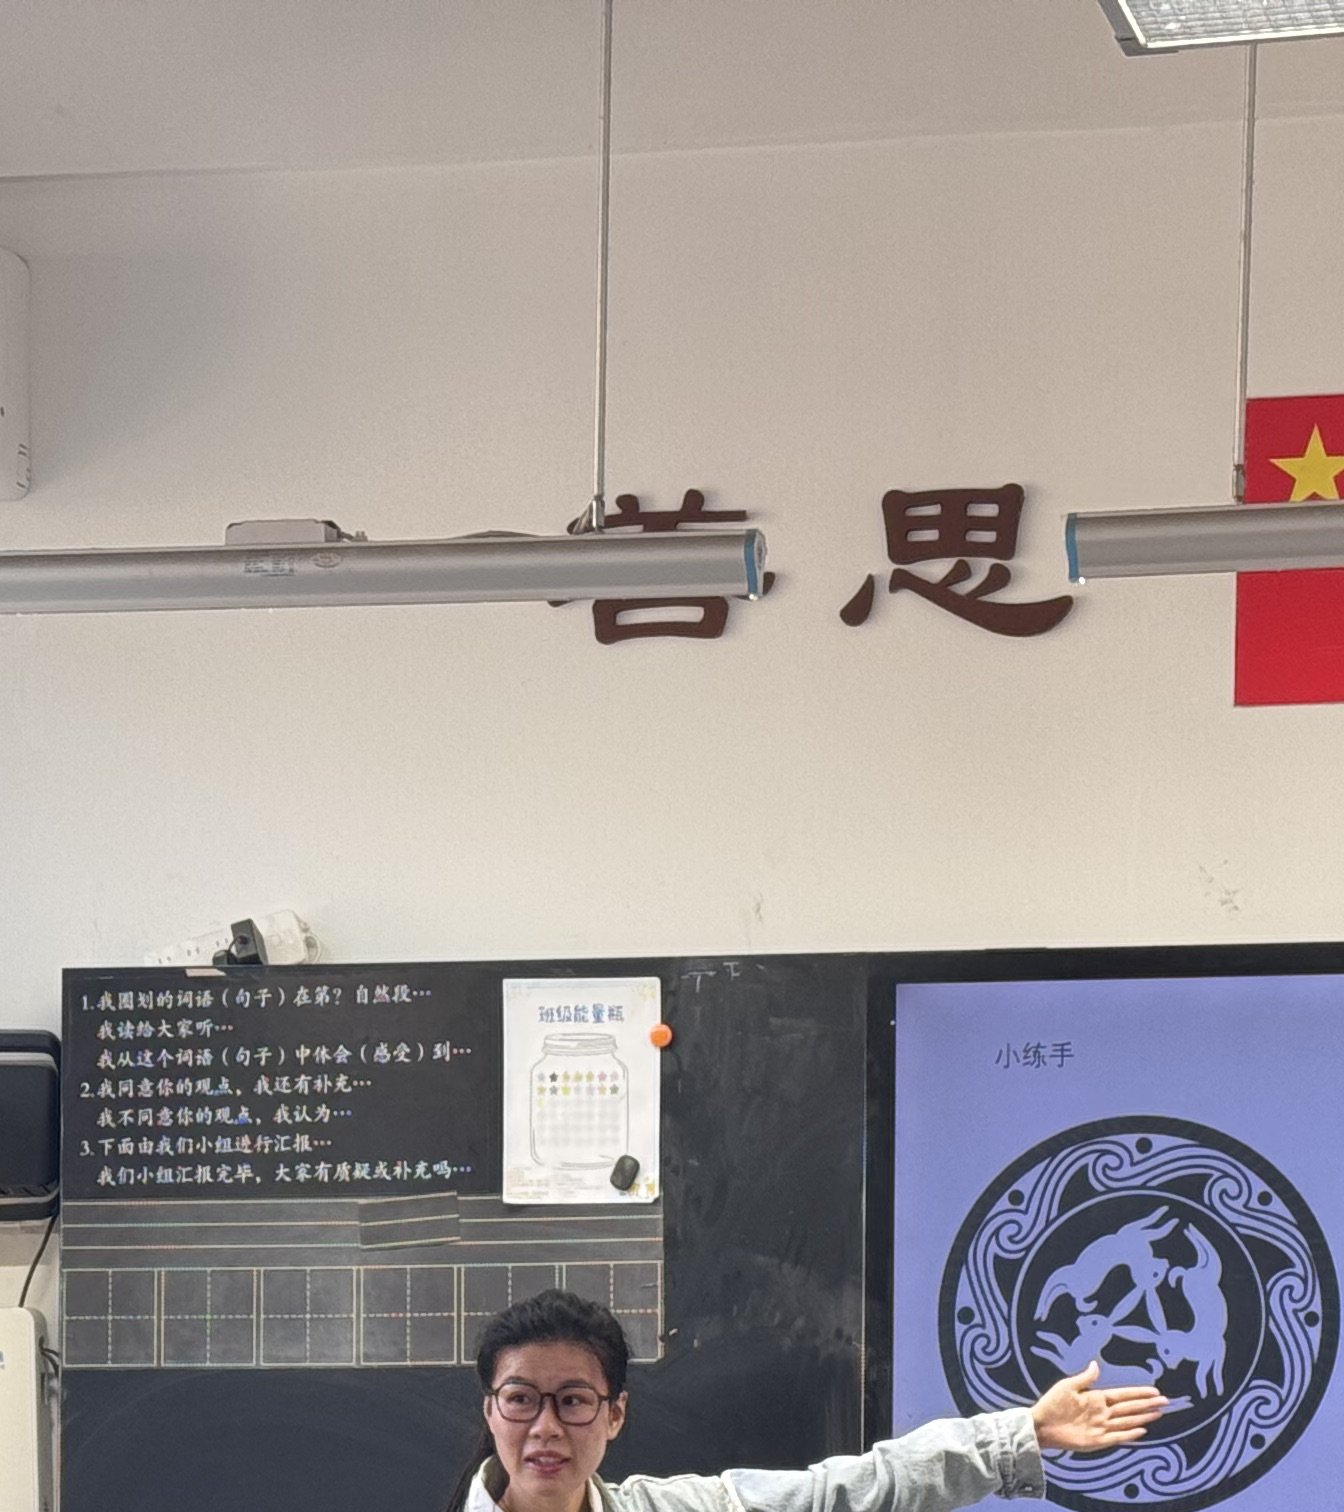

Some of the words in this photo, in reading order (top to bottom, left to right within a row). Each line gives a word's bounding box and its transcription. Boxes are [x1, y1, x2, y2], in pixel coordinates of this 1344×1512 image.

[539, 1003, 625, 1024] 班级能量瓶
[995, 1041, 1075, 1069] 小练手
